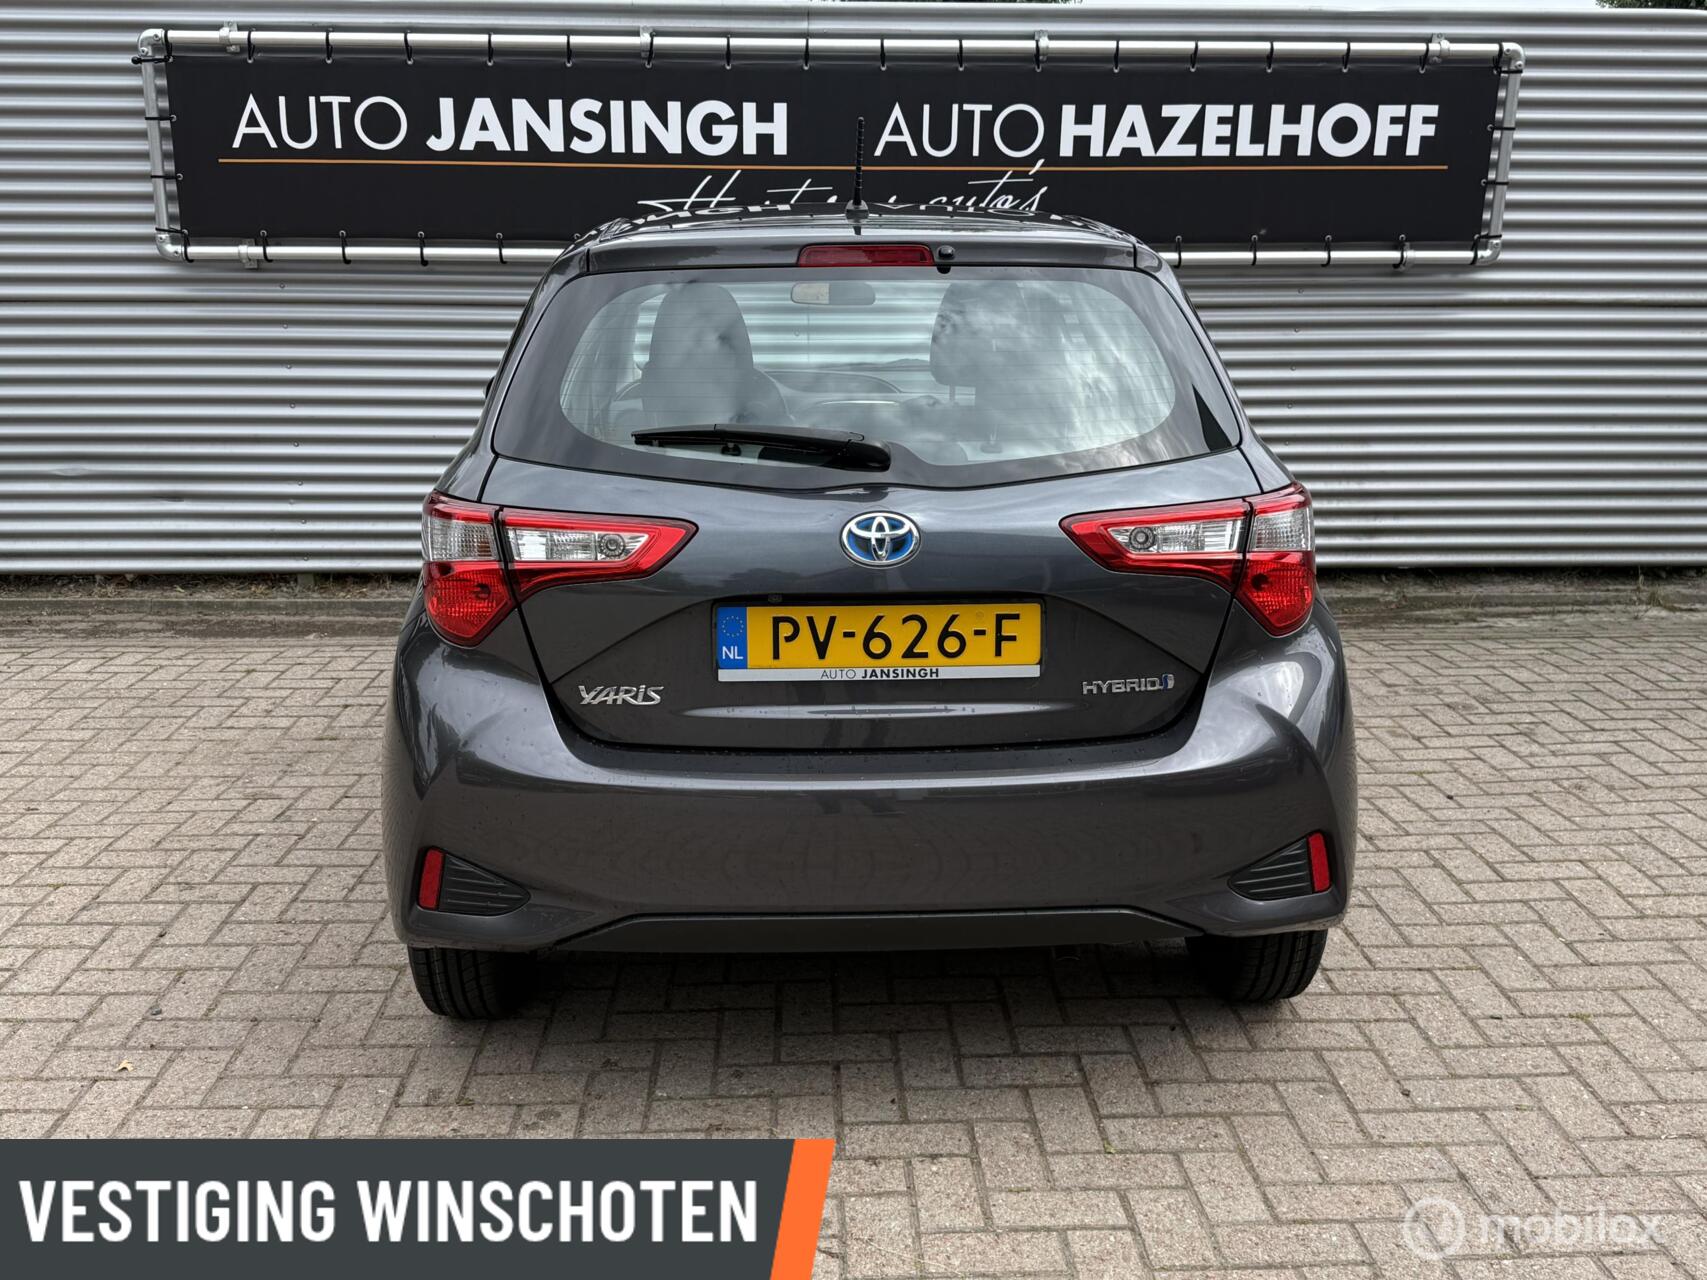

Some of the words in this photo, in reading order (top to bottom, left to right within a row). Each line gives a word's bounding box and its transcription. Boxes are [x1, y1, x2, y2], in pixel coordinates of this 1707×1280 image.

[232, 94, 408, 150] AUTO
[426, 98, 788, 156] JANSINGH
[874, 102, 1045, 158] AUTO
[1059, 103, 1440, 157] HAZELHOFF
[771, 613, 1021, 660] PV-626-F
[722, 646, 744, 660] NL
[820, 669, 857, 679] AUTO
[861, 668, 940, 679] JANSINGH
[1082, 677, 1162, 695] HYBRID
